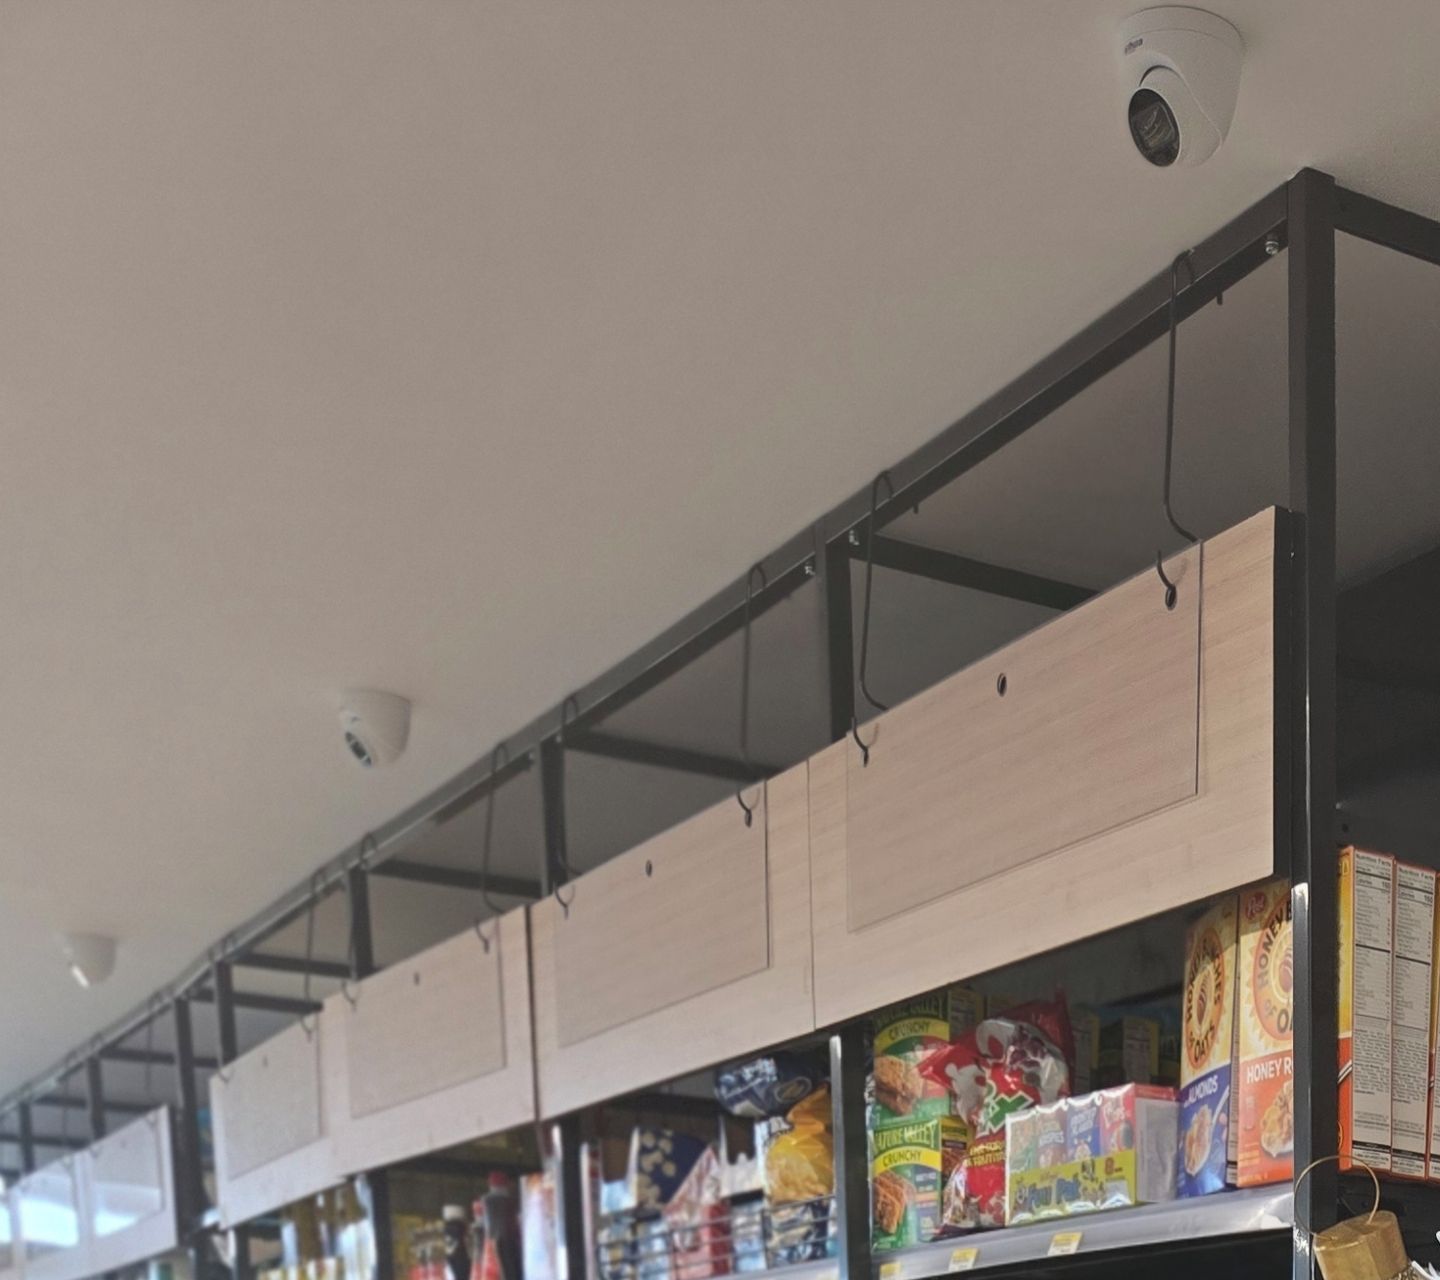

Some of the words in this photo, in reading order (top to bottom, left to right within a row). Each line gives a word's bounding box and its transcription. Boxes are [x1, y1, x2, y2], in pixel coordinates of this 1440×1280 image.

[888, 1020, 930, 1041] CRUNCHY
[1246, 1056, 1280, 1084] HONEY
[882, 1150, 922, 1167] CRUNCHY
